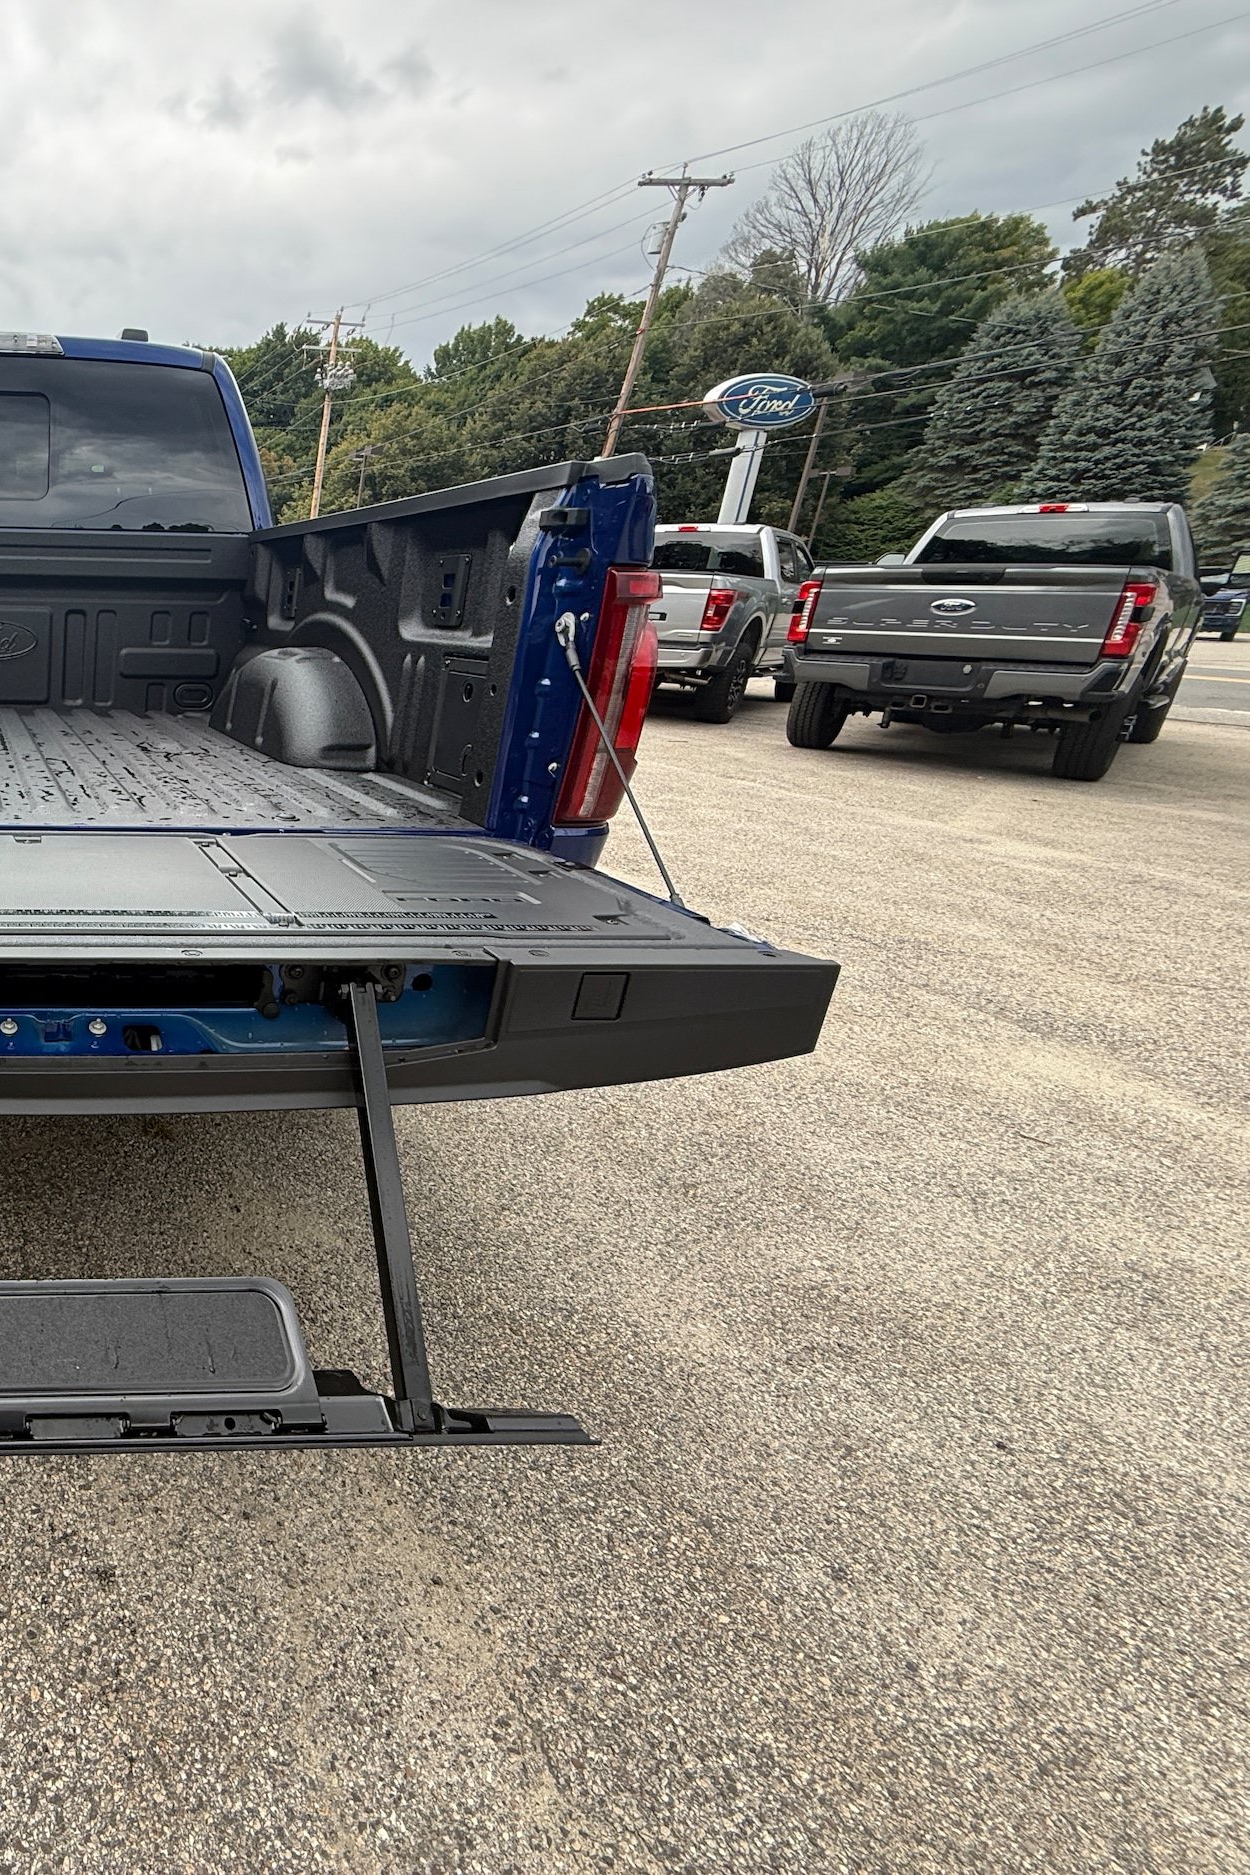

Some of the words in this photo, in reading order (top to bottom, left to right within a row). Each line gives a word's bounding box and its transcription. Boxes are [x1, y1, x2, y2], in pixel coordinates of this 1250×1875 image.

[738, 384, 801, 417] Ford
[827, 617, 958, 629] SUPER
[970, 620, 1089, 633] DUTY
